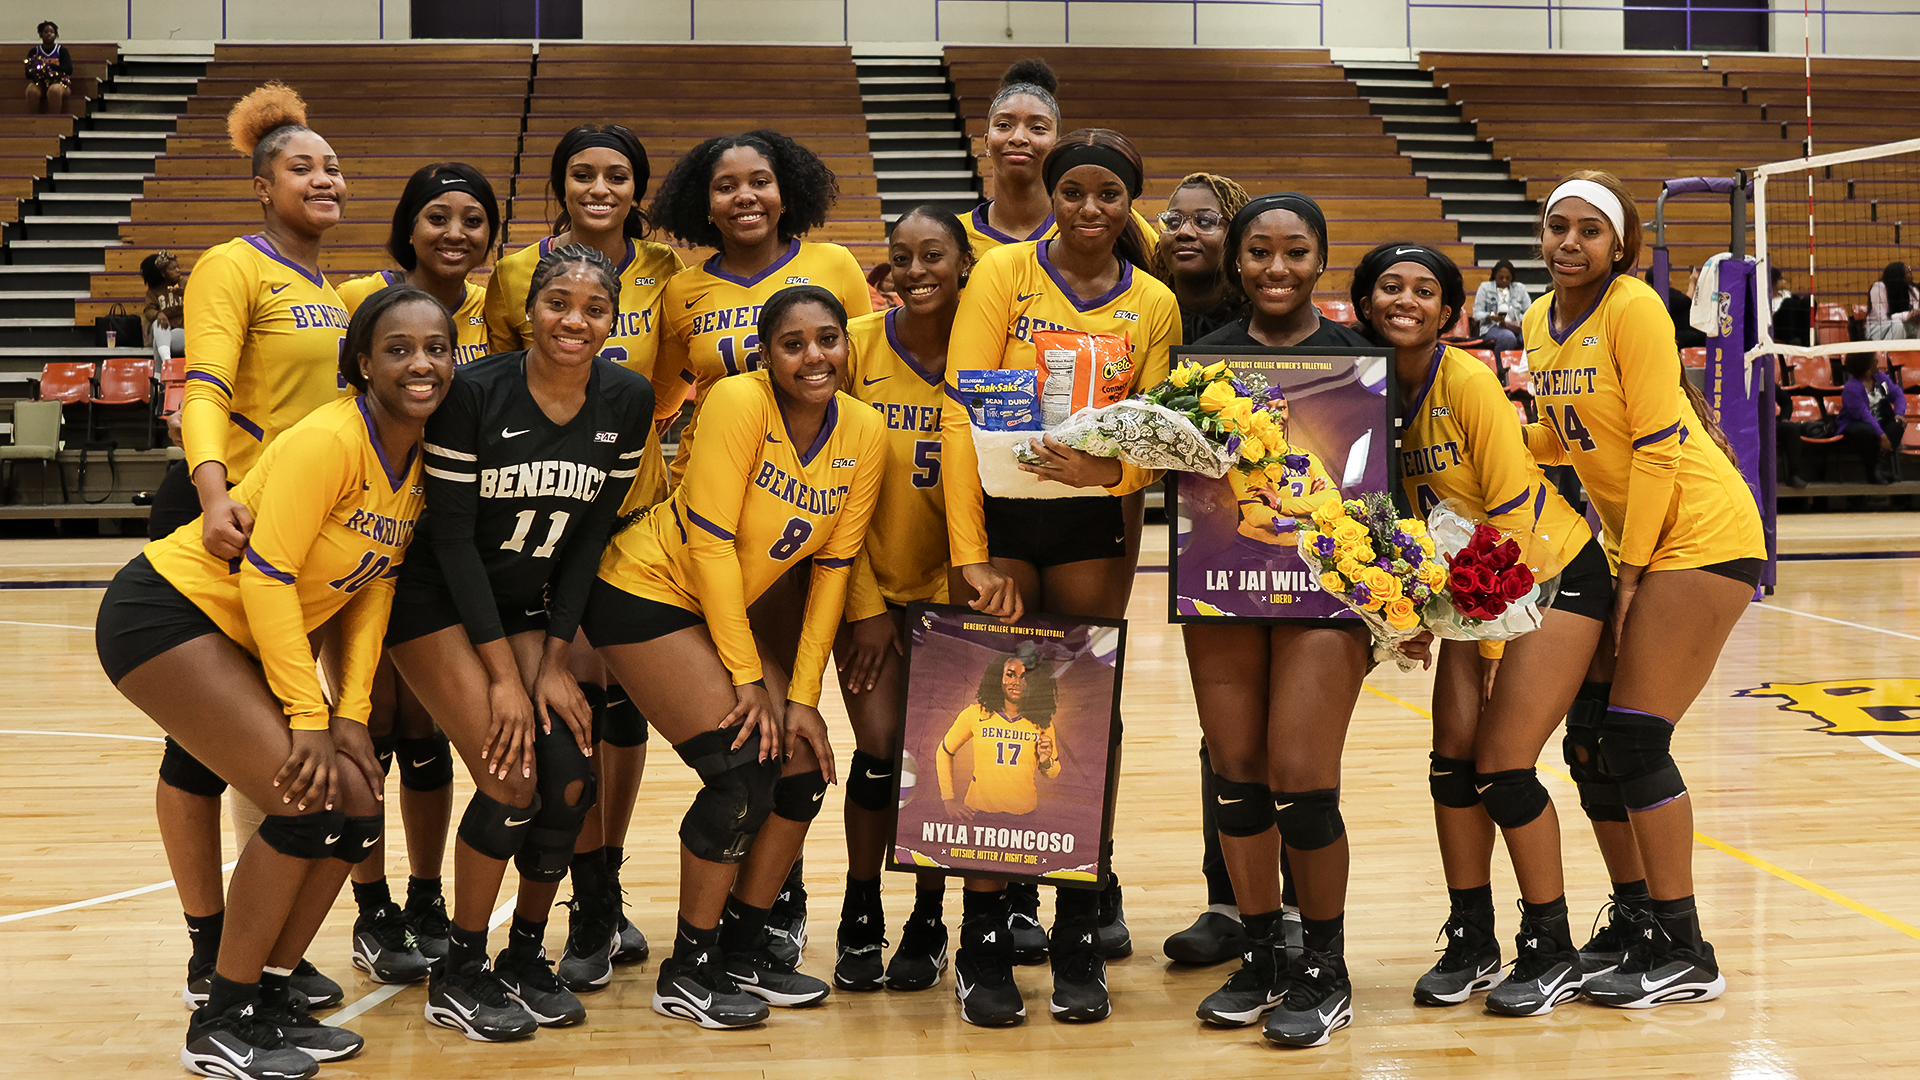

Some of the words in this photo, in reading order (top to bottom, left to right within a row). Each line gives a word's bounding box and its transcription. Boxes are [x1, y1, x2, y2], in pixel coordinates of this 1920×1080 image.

[1545, 403, 1598, 453] 14
[910, 439, 942, 489] 5
[754, 459, 849, 516] BENEDICT
[500, 510, 570, 558] 11
[767, 515, 814, 562] 8
[326, 549, 391, 594] 10
[1238, 570, 1266, 591] JAI
[1271, 570, 1321, 592] WILS
[1269, 593, 1293, 604] LIBERO
[963, 622, 987, 632] BENEDICT
[987, 624, 1009, 634] COLLEGE
[1010, 626, 1034, 636] WOMEN'S
[1035, 628, 1065, 639] VOLLEYBALL
[981, 727, 1039, 742] BENEDICT
[996, 741, 1022, 766] 17
[921, 821, 968, 845] NYLA
[973, 826, 1075, 854] TRONCOSO
[950, 847, 976, 859] OUTSIDE
[976, 849, 998, 862] HITTER
[1004, 852, 1023, 864] RIGHT
[1023, 854, 1038, 865] SIDE
